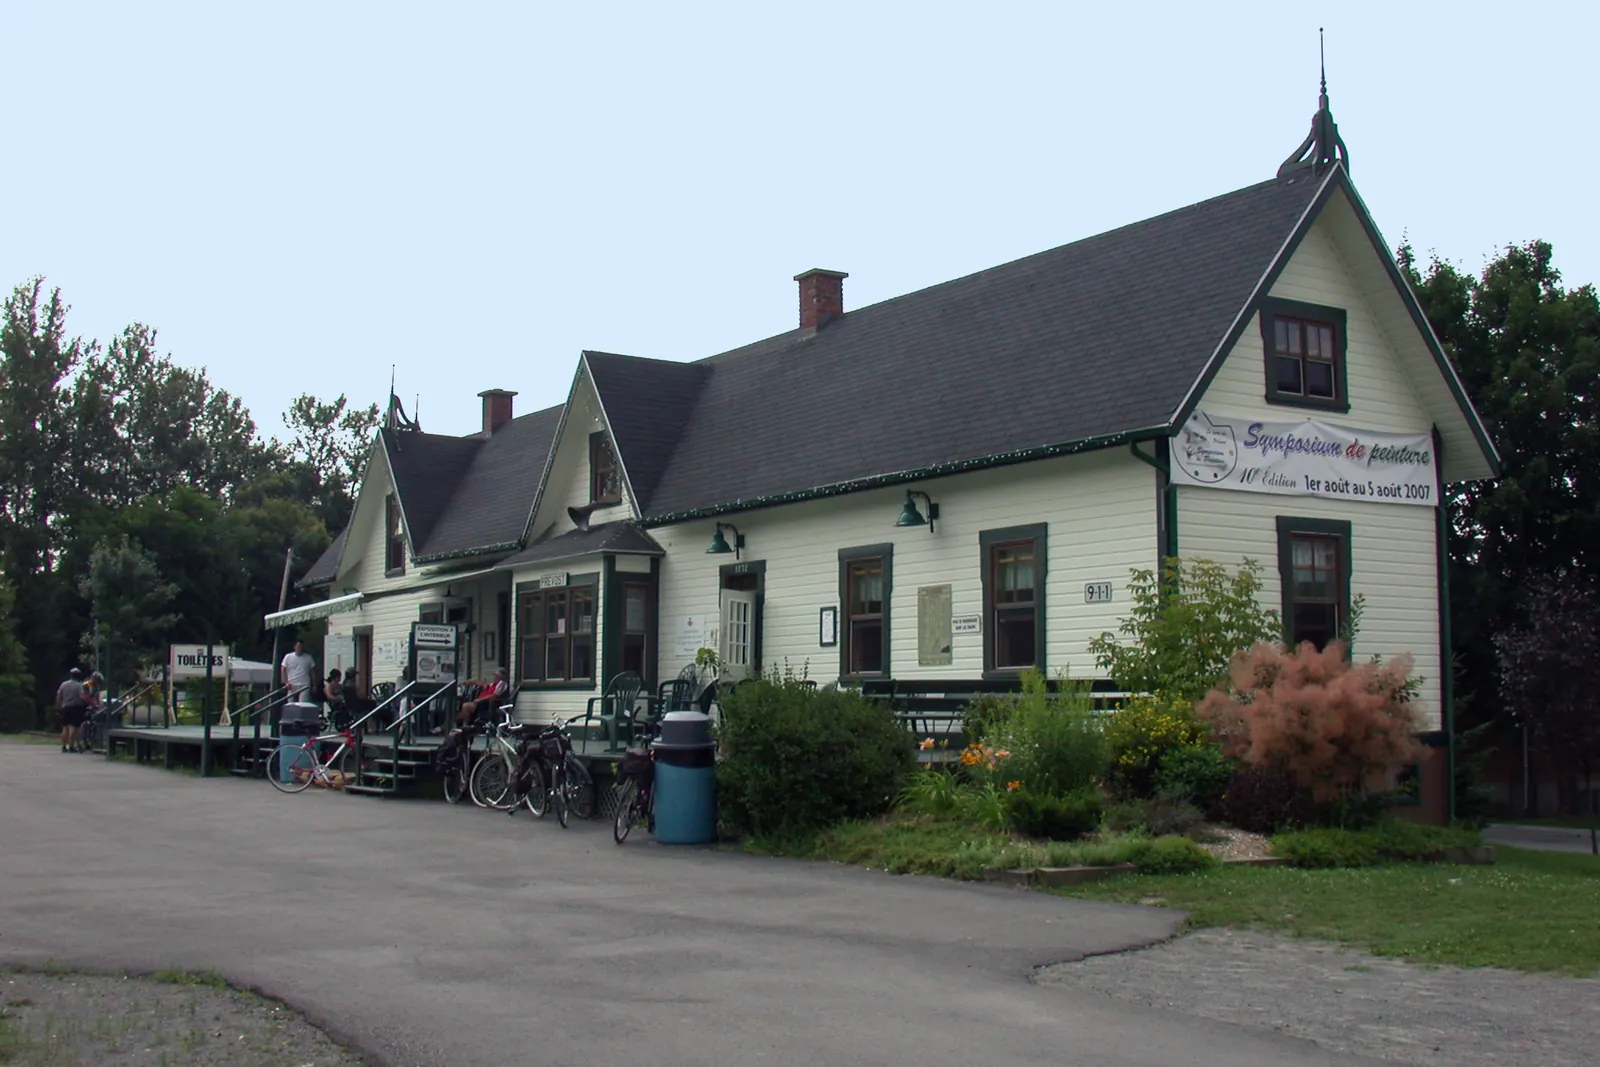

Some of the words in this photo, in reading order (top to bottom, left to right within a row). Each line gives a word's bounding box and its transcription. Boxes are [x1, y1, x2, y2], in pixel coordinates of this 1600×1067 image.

[1243, 422, 1342, 458] Symposium
[1345, 438, 1366, 460] de
[1367, 443, 1430, 468] peinture
[1262, 466, 1297, 489] Édition
[1304, 474, 1321, 491] 1er
[1324, 478, 1350, 494] août
[1352, 483, 1366, 495] au
[1368, 481, 1374, 496] 5
[1377, 483, 1402, 499] août
[1404, 484, 1430, 500] 2007
[1087, 584, 1109, 600] 9-1-1
[177, 654, 223, 666] TOILETES
